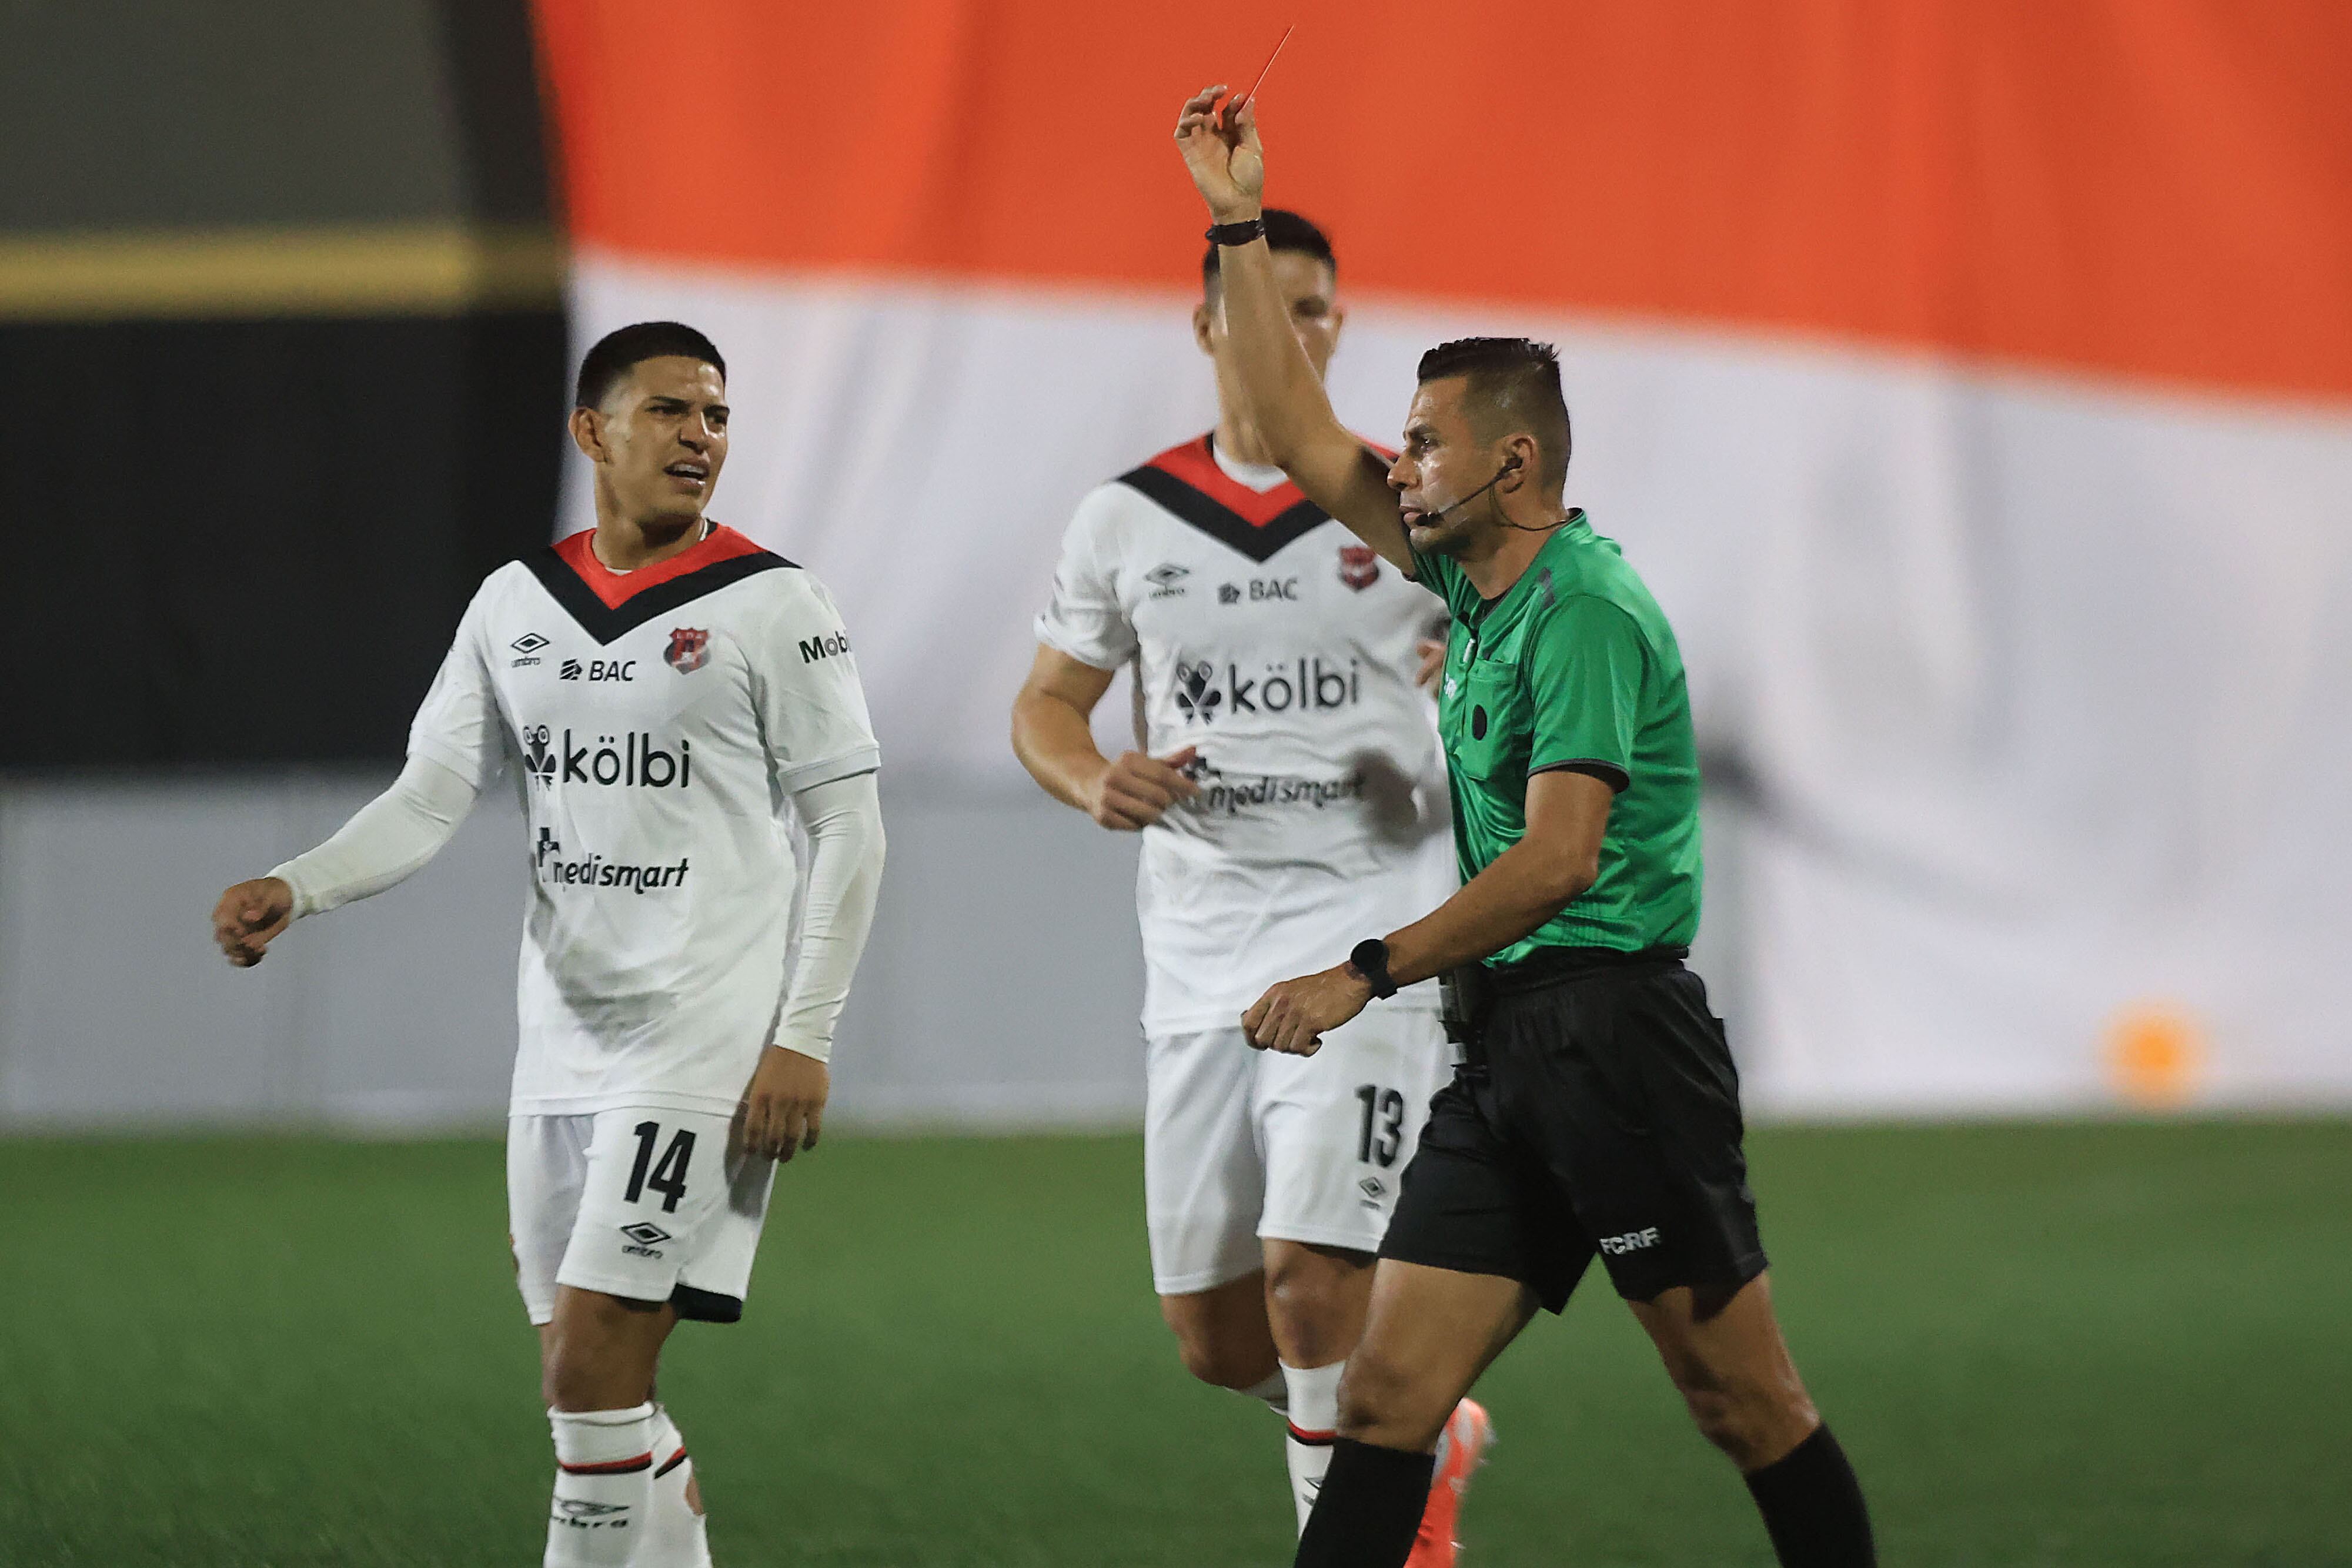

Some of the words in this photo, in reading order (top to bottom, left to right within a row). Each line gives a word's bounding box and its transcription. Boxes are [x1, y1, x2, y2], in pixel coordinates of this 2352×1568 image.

[1250, 577, 1298, 601] BAC
[589, 660, 636, 681] BAC
[1228, 657, 1358, 713] kölbi
[562, 728, 690, 788] kölbi
[1355, 1085, 1404, 1168] 13
[624, 1121, 696, 1213] 14
[1599, 1227, 1660, 1255] FCRF
